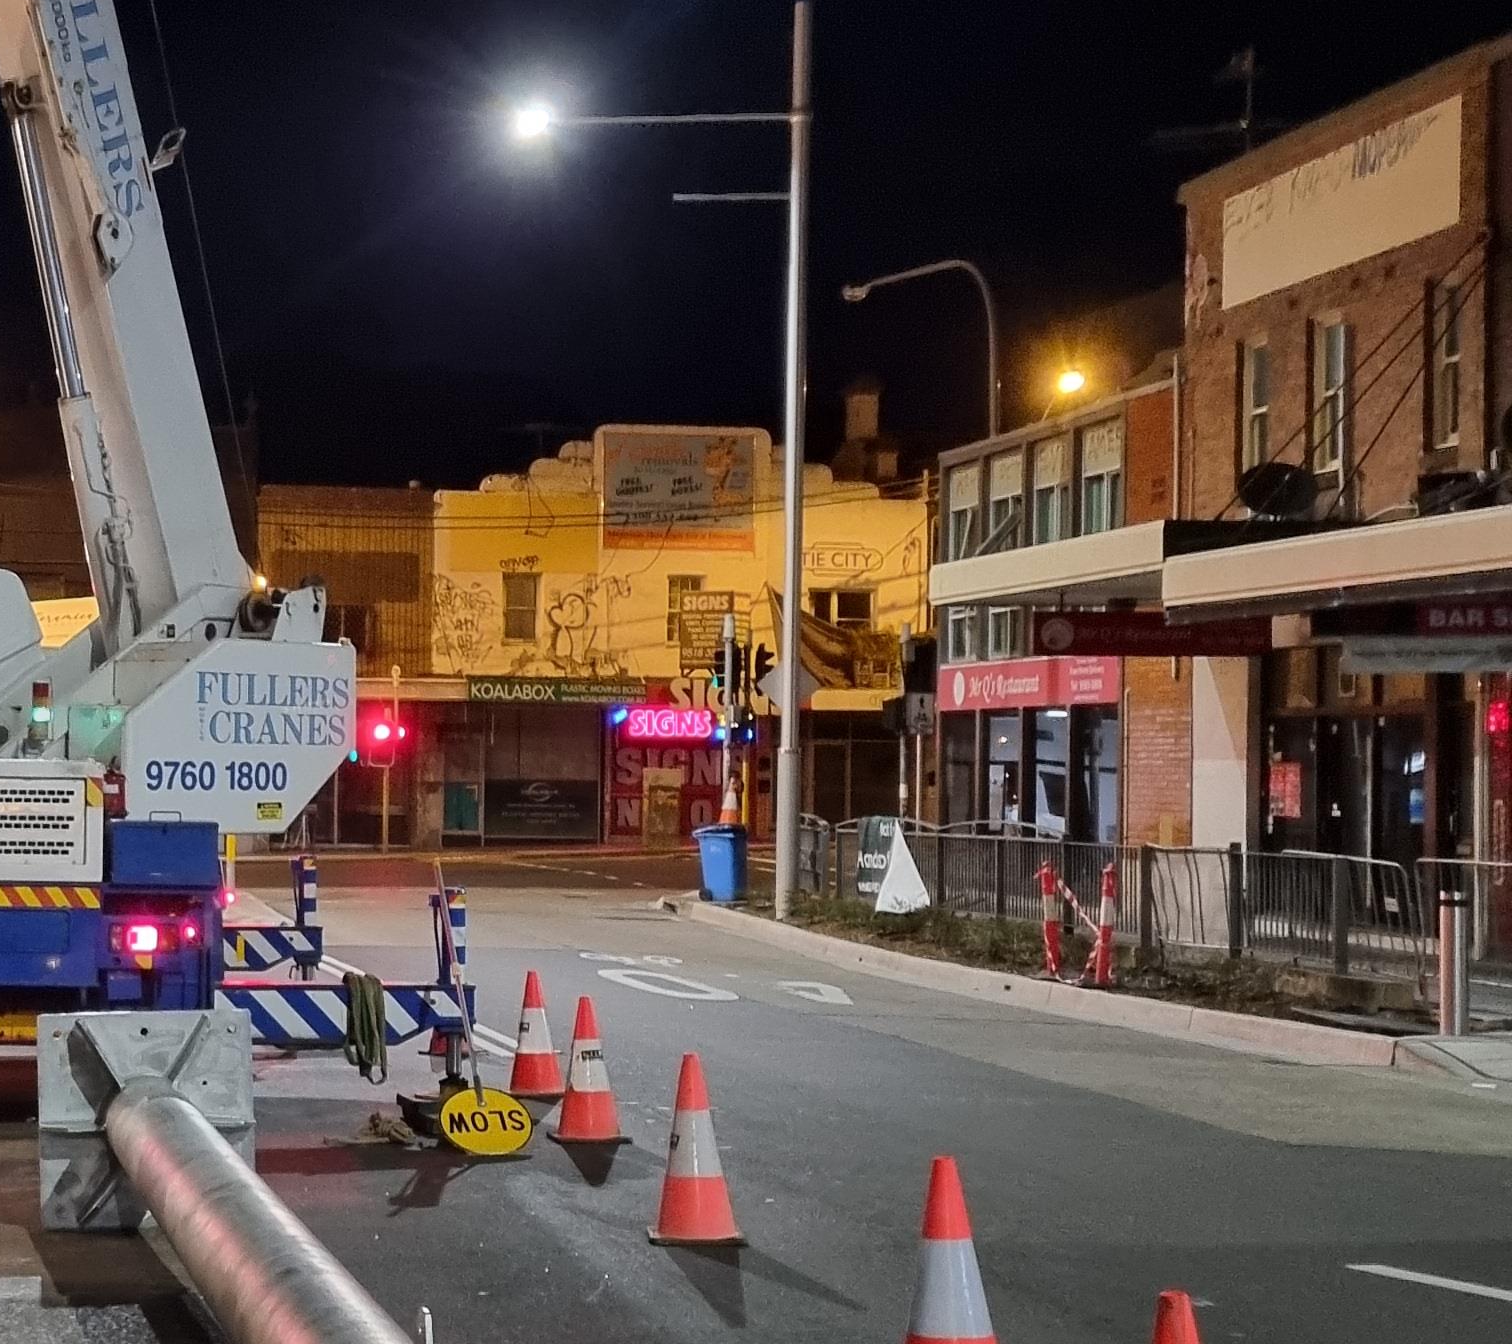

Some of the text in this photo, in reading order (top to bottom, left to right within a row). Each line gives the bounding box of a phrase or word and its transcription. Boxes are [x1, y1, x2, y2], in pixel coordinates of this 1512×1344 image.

[831, 552, 872, 568] CITY
[682, 595, 729, 611] SIGNS
[1428, 607, 1512, 628] BAR S
[196, 671, 349, 710] FULLERS
[471, 683, 556, 701] KOALABOX
[590, 685, 622, 694] MOVING
[622, 685, 646, 695] BOXES
[996, 673, 1040, 700] Restaurant
[208, 710, 346, 746] CRANES
[627, 709, 713, 738] SIGNS
[145, 759, 288, 792] 9760 1800
[448, 1109, 526, 1134] SLOW
